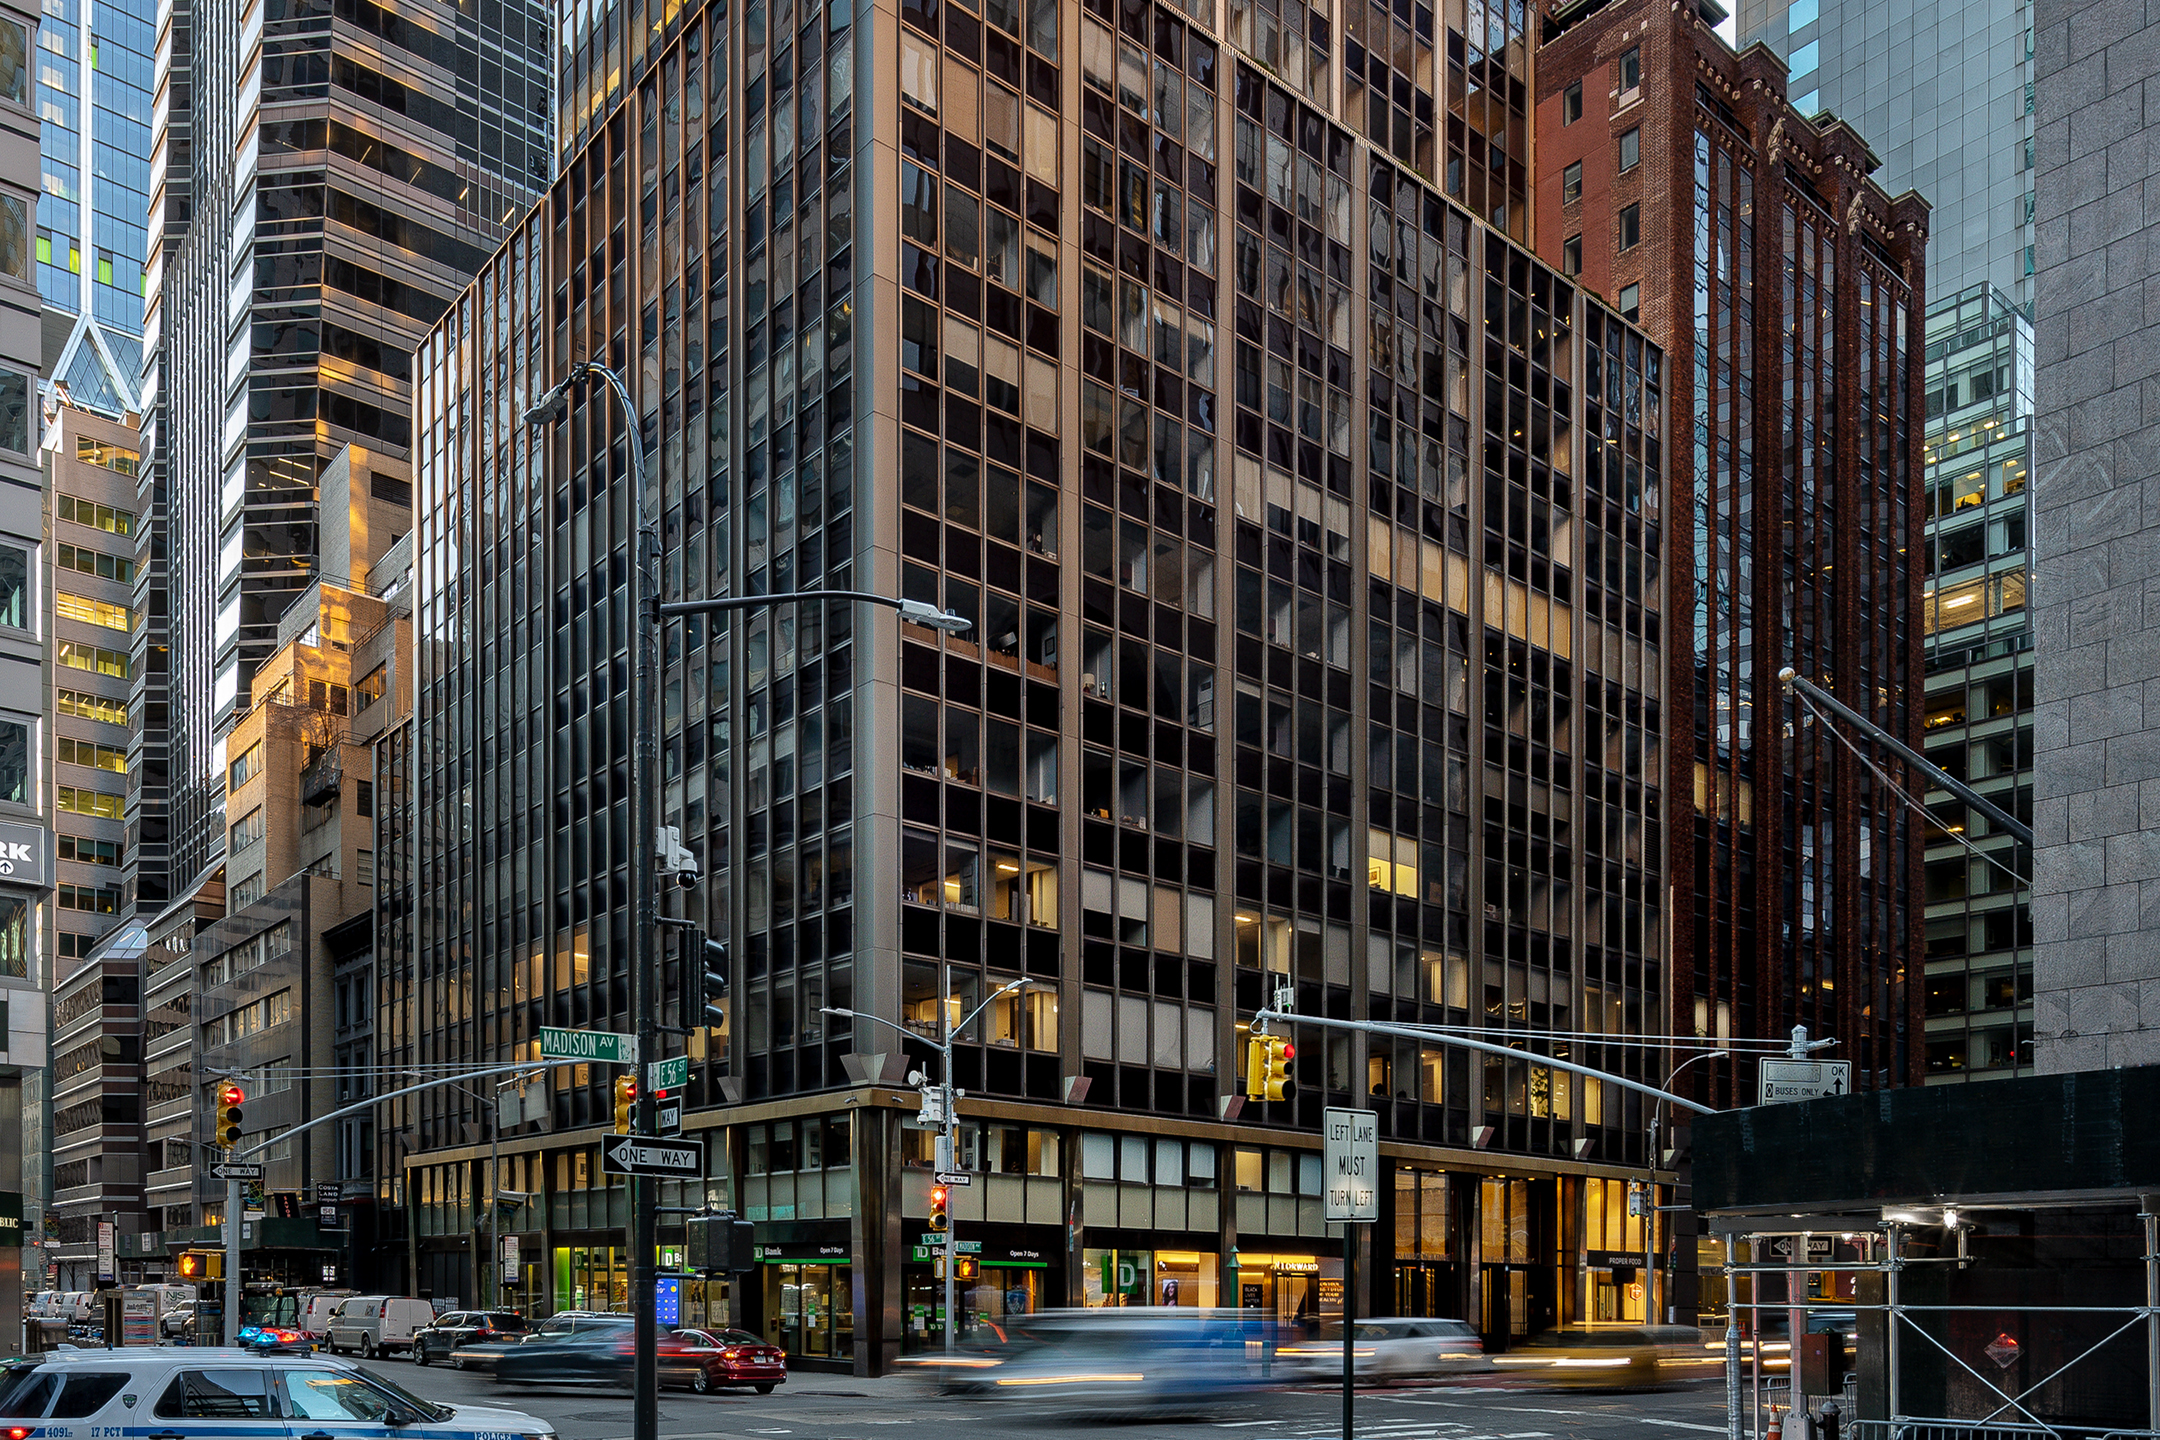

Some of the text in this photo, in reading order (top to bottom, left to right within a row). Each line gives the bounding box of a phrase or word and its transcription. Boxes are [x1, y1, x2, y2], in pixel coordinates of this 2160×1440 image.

[543, 1031, 615, 1056] MADISON AV
[661, 1060, 686, 1085] E 56 ST
[1831, 1066, 1845, 1076] OK
[1775, 1087, 1819, 1096] BUSES ONLY
[1330, 1124, 1373, 1142] LEFT LANE
[619, 1147, 690, 1166] ONE WAY
[1338, 1155, 1365, 1176] MUST
[1330, 1190, 1373, 1206] TURN LEFT
[1780, 1240, 1826, 1250] ON AY
[765, 1247, 782, 1256] Bank
[819, 1247, 830, 1255] Open
[834, 1247, 844, 1255] Days
[914, 1245, 929, 1258] TD
[1010, 1250, 1023, 1258] Open
[1027, 1250, 1039, 1259] Days
[1608, 1257, 1642, 1266] PROPER FOOD
[47, 1427, 68, 1437] 4091
[91, 1427, 121, 1437] 17 PCT
[474, 1431, 511, 1440] POLICE
